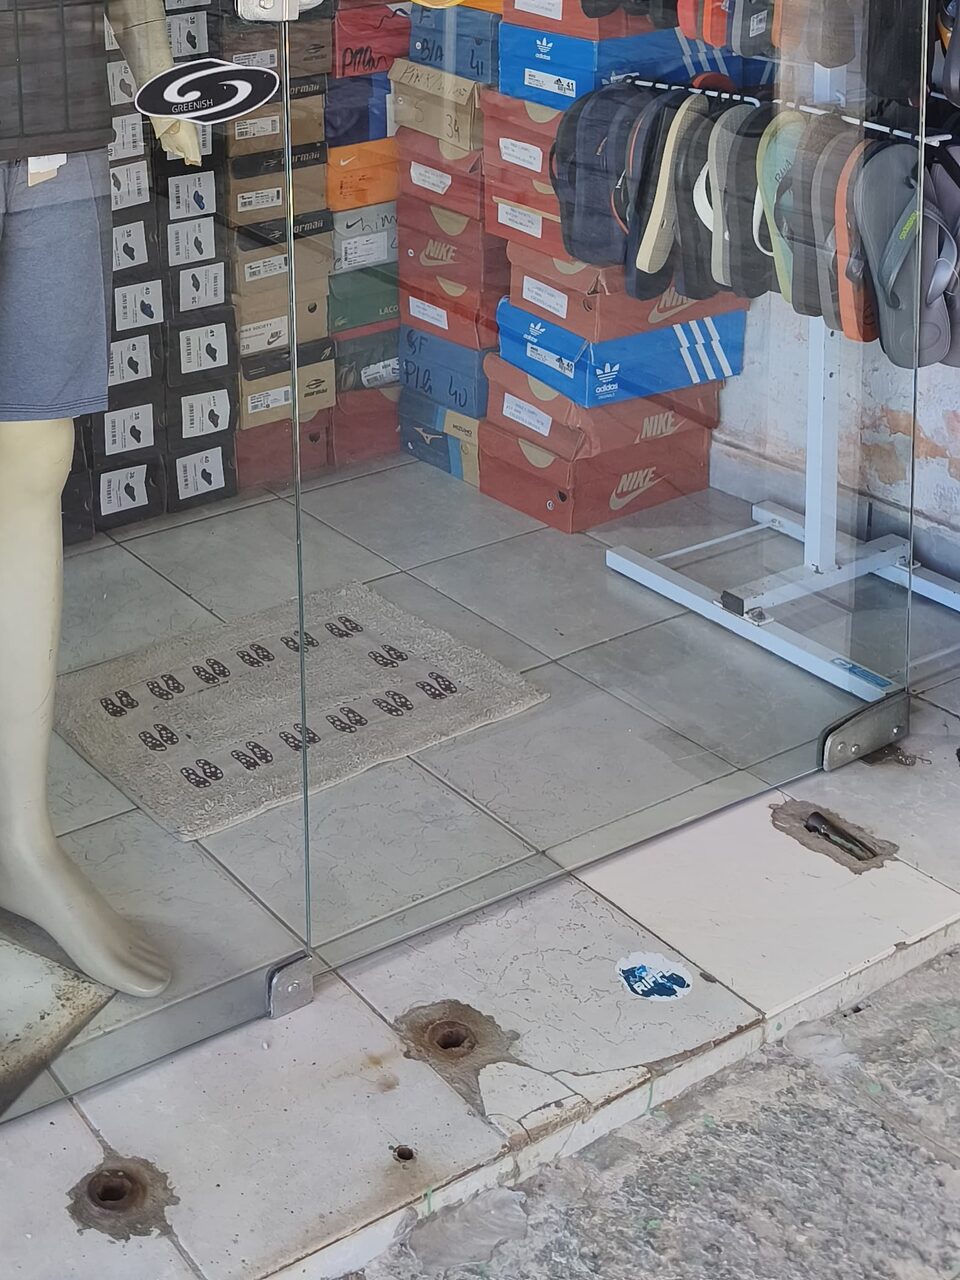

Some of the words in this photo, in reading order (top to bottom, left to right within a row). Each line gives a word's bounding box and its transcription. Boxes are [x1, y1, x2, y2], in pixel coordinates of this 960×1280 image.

[171, 98, 214, 114] GREENISH
[425, 239, 458, 262] NIKE
[595, 382, 619, 394] adidas
[640, 410, 676, 439] NIKE
[616, 466, 657, 494] NIKE
